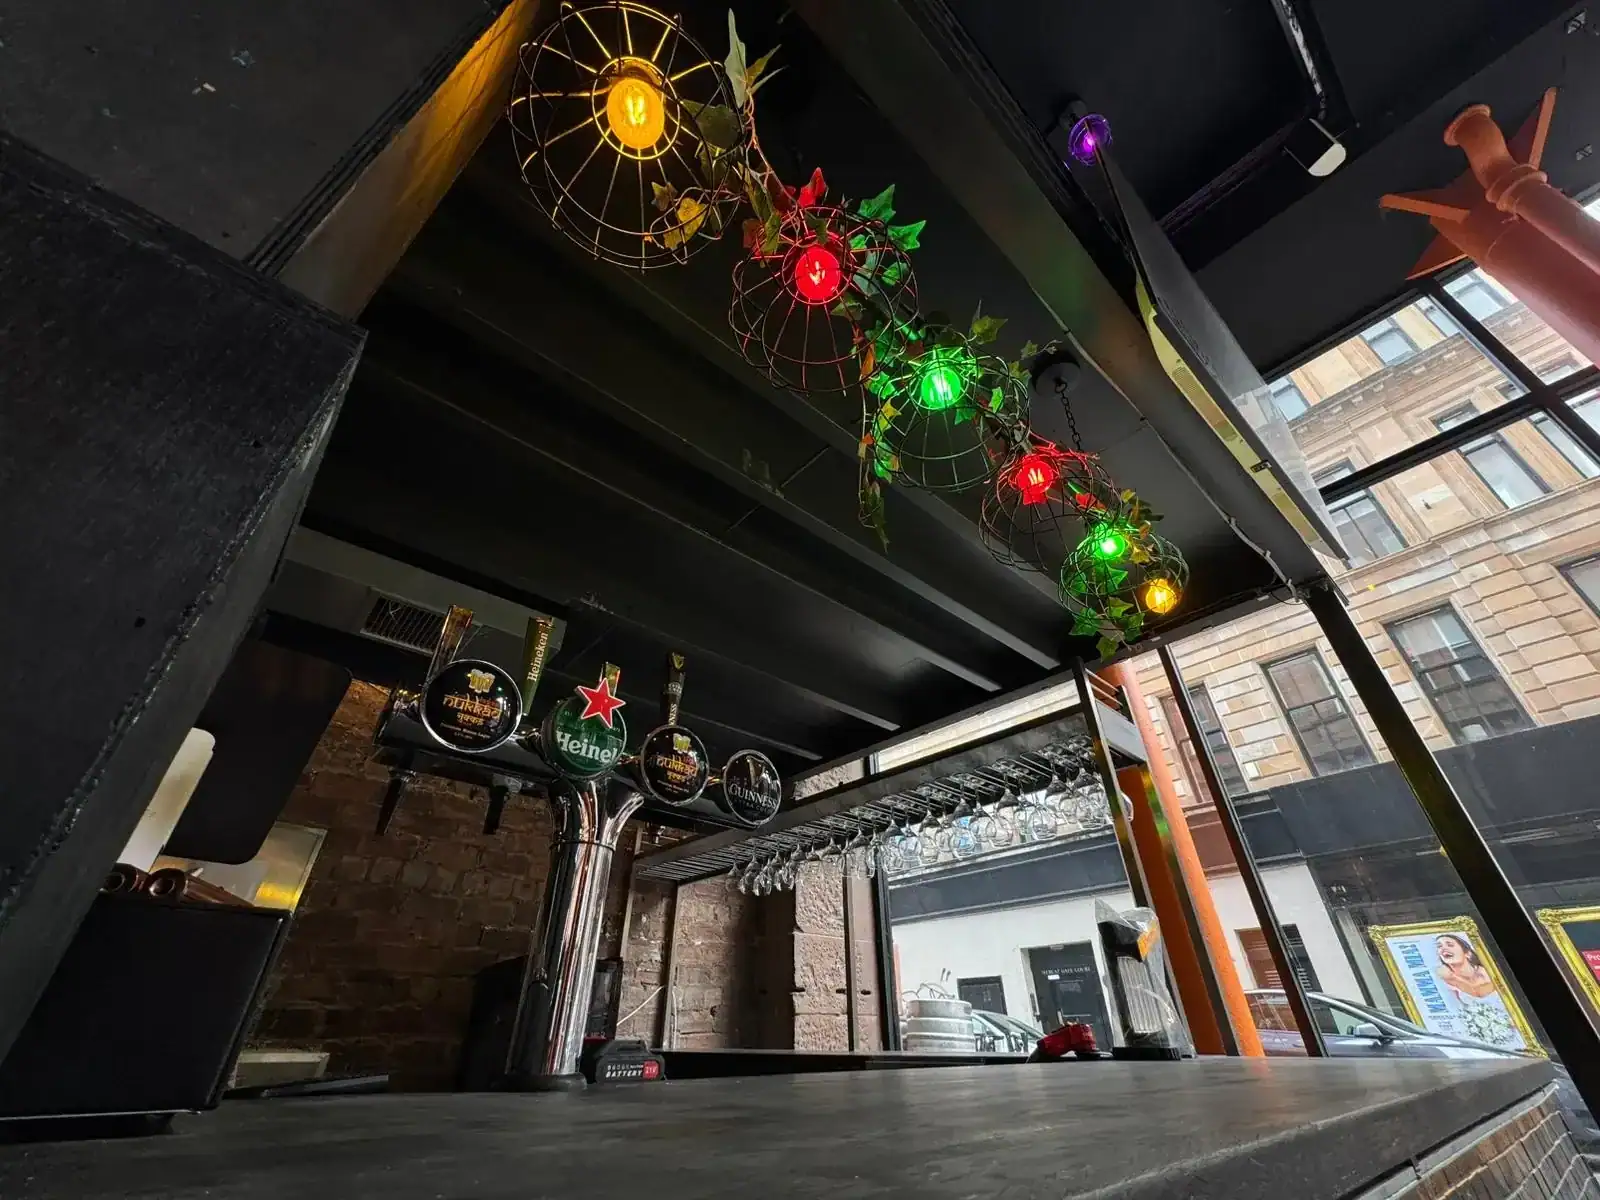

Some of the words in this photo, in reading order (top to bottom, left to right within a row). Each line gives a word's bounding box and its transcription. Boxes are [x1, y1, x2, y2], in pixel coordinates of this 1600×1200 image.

[526, 631, 548, 682] Heineken
[728, 783, 778, 809] GUINNESS
[605, 1070, 642, 1078] BATTERY
